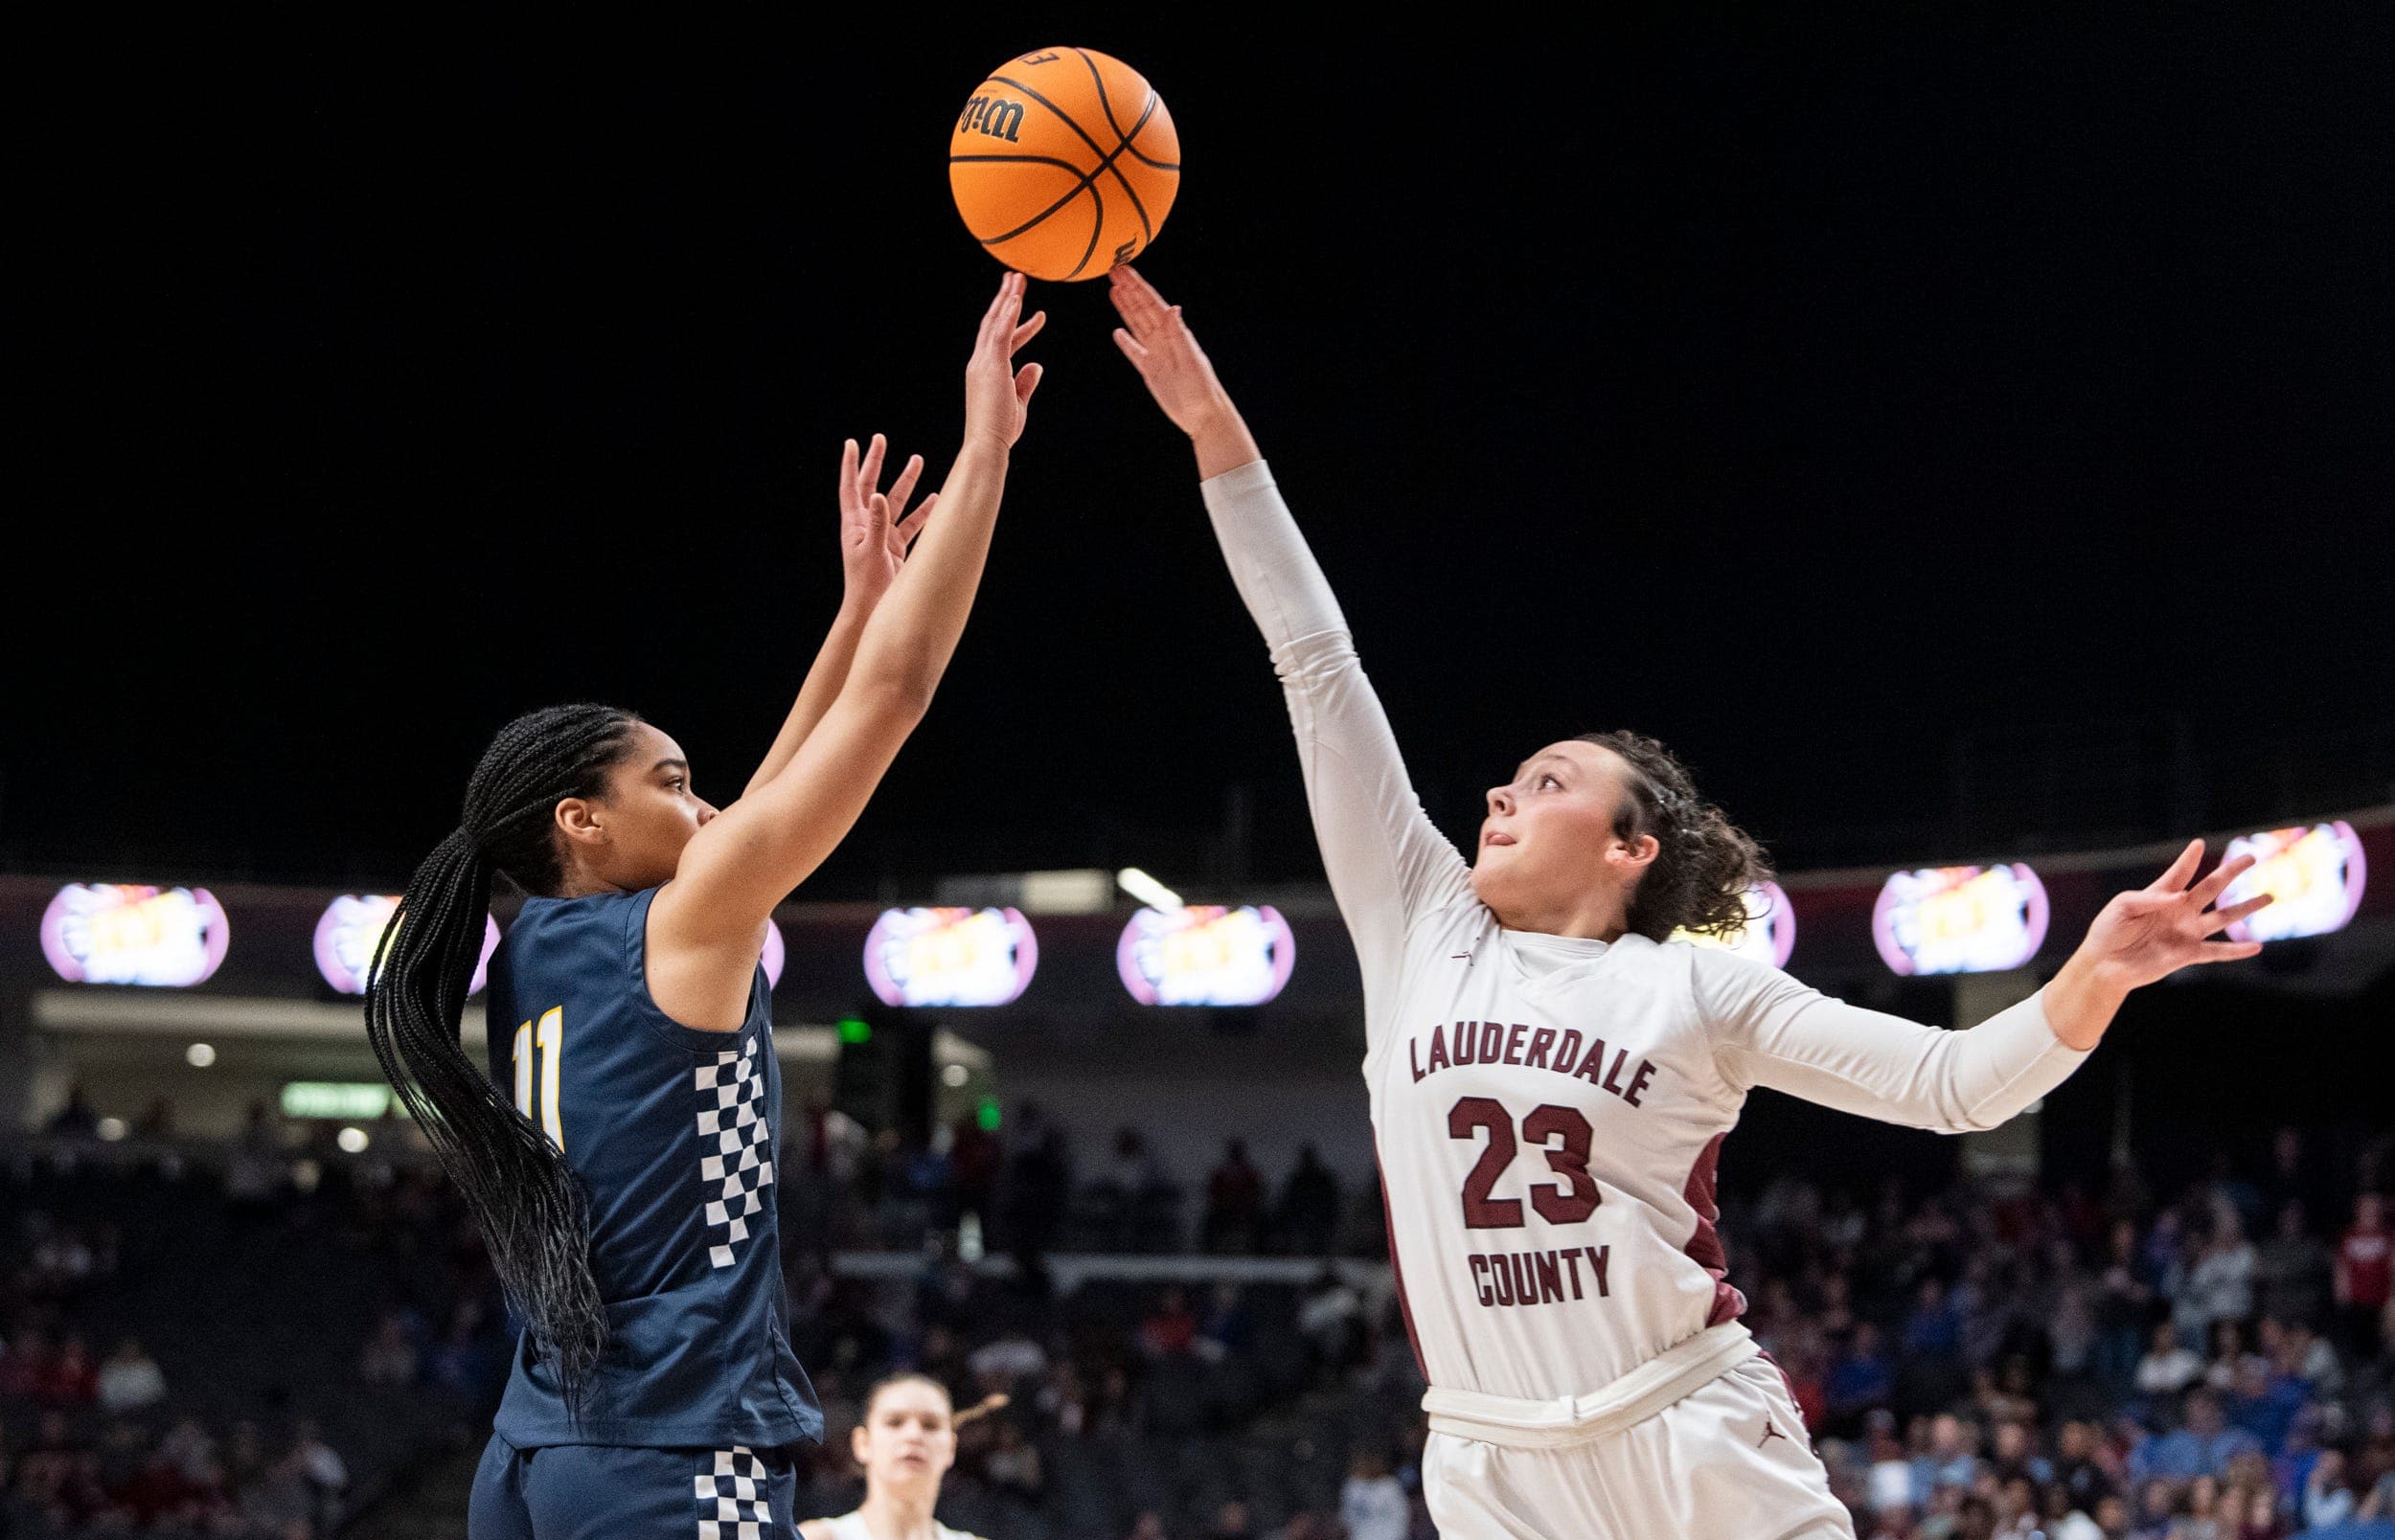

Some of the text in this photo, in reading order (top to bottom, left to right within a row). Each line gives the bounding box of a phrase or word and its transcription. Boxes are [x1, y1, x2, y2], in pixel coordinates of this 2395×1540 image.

[512, 1005, 565, 1153] 11
[1410, 1021, 1656, 1108] LAUDERDALE
[1448, 1096, 1602, 1229] 23
[1468, 1245, 1609, 1306] COUNTY
